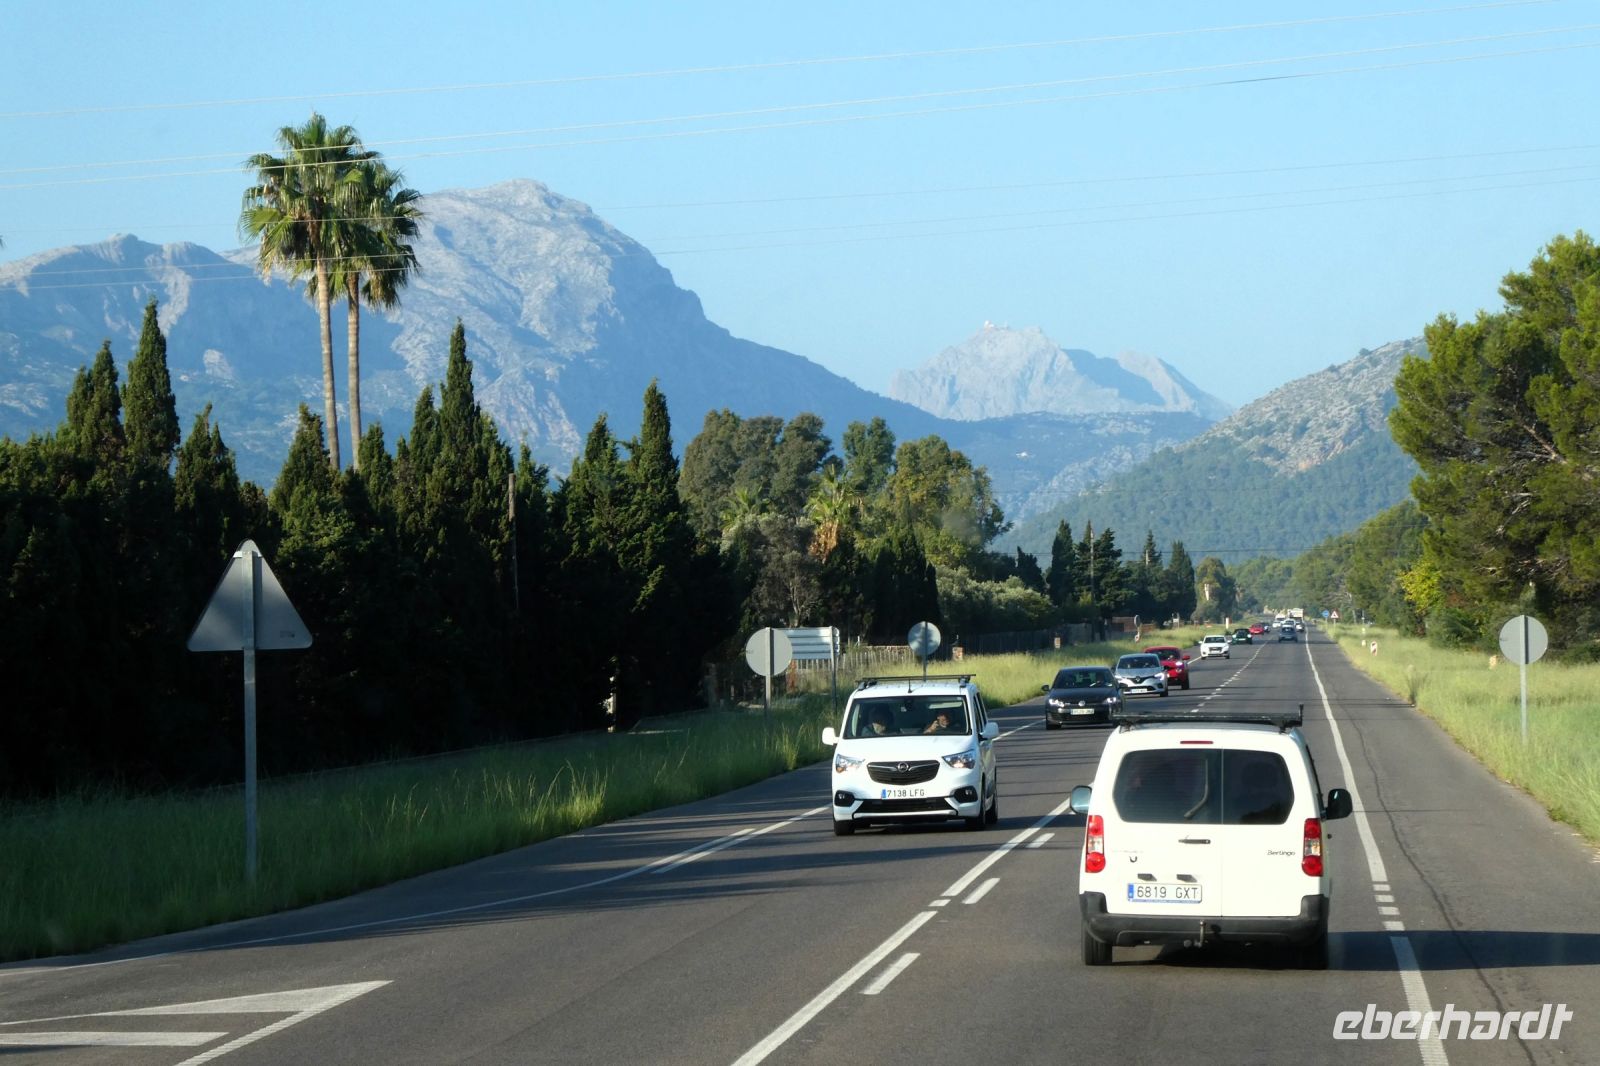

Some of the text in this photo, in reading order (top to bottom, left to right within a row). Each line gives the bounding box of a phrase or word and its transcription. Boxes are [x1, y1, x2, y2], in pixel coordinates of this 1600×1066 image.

[887, 788, 925, 798] 7138 LFG
[1266, 849, 1296, 857] Berlingo
[1137, 886, 1198, 899] 6819 GXT
